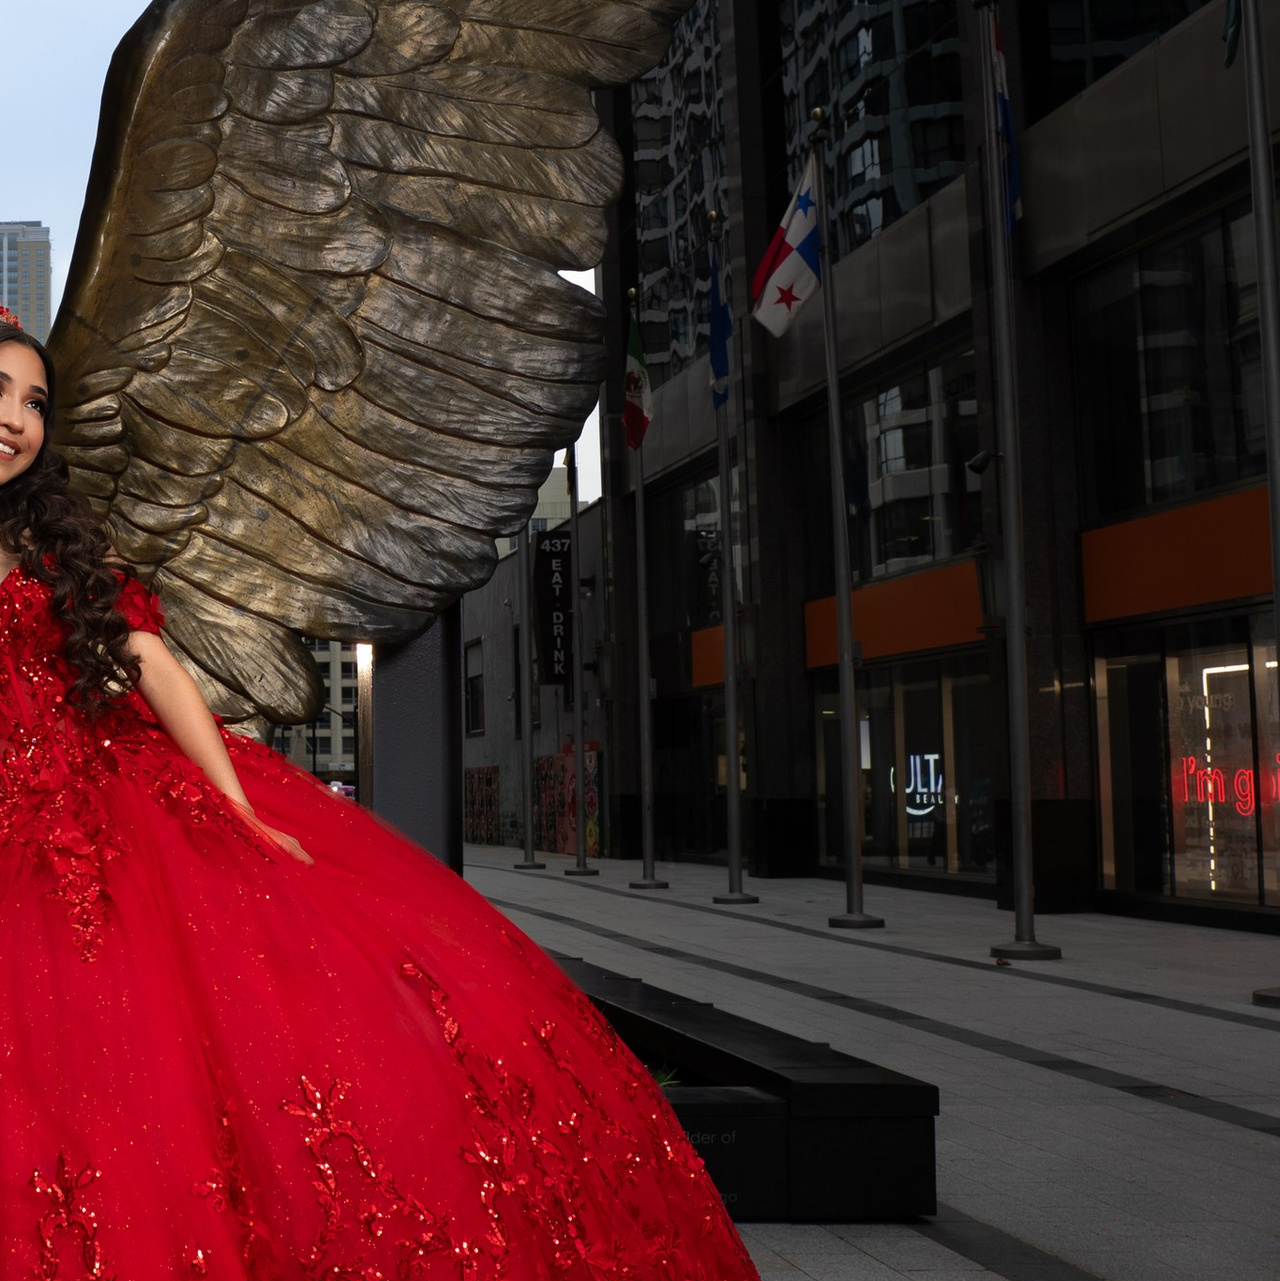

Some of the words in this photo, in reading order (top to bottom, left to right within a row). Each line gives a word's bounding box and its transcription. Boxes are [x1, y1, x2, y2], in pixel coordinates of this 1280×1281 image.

[540, 539, 570, 552] 437
[551, 558, 562, 596] EAT
[552, 611, 565, 675] DRINK
[1182, 756, 1226, 802] I'm
[721, 1130, 736, 1144] of
